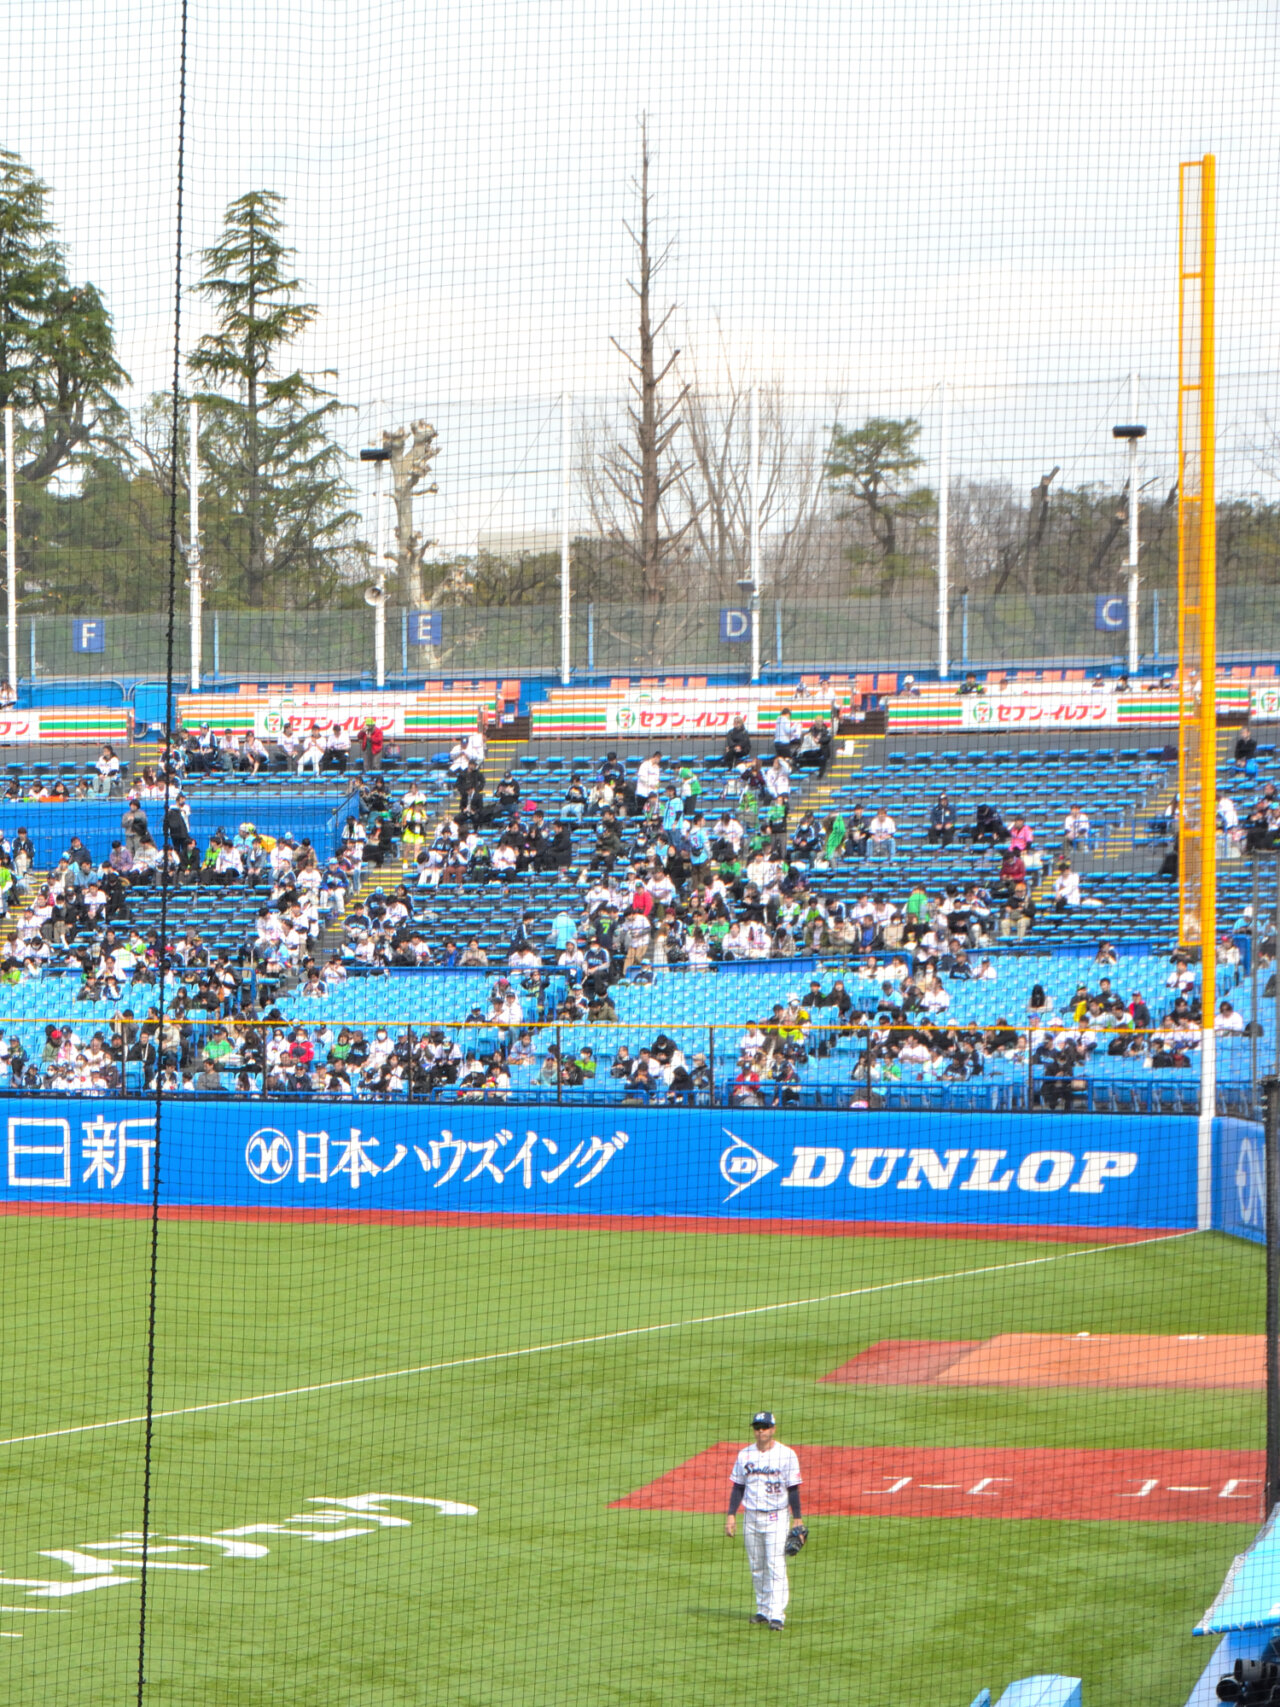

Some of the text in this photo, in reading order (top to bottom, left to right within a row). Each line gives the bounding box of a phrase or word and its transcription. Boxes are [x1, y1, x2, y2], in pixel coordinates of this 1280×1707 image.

[726, 611, 747, 637] D
[1102, 599, 1122, 625] C
[81, 622, 96, 648] F
[417, 614, 432, 640] E
[297, 1128, 629, 1189] 日本ハウズイング
[781, 1146, 1138, 1194] DUNLOP
